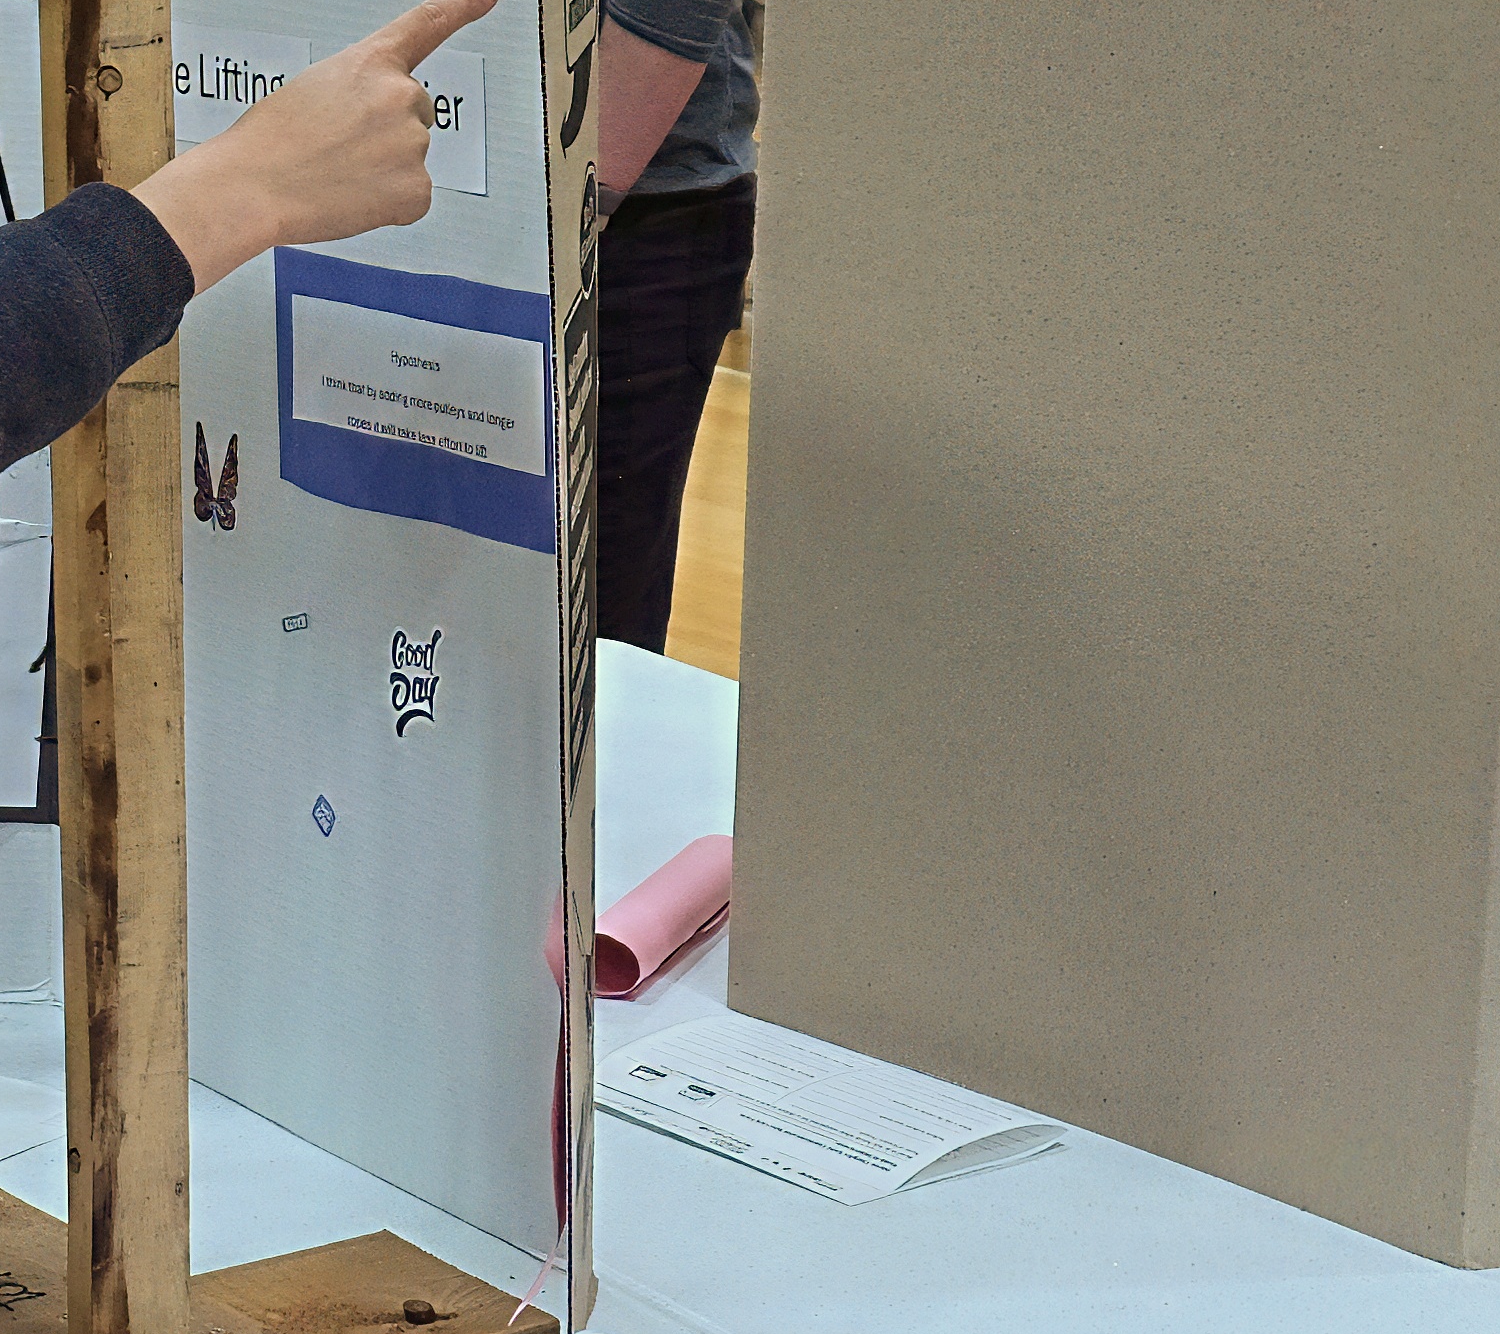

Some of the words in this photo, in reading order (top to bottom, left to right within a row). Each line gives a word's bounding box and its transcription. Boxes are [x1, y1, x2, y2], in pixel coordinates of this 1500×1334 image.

[367, 384, 377, 401] by
[409, 397, 433, 411] more
[434, 400, 466, 420] pulleys
[467, 407, 485, 423] and
[391, 628, 443, 675] Good
[389, 671, 440, 737] Day
